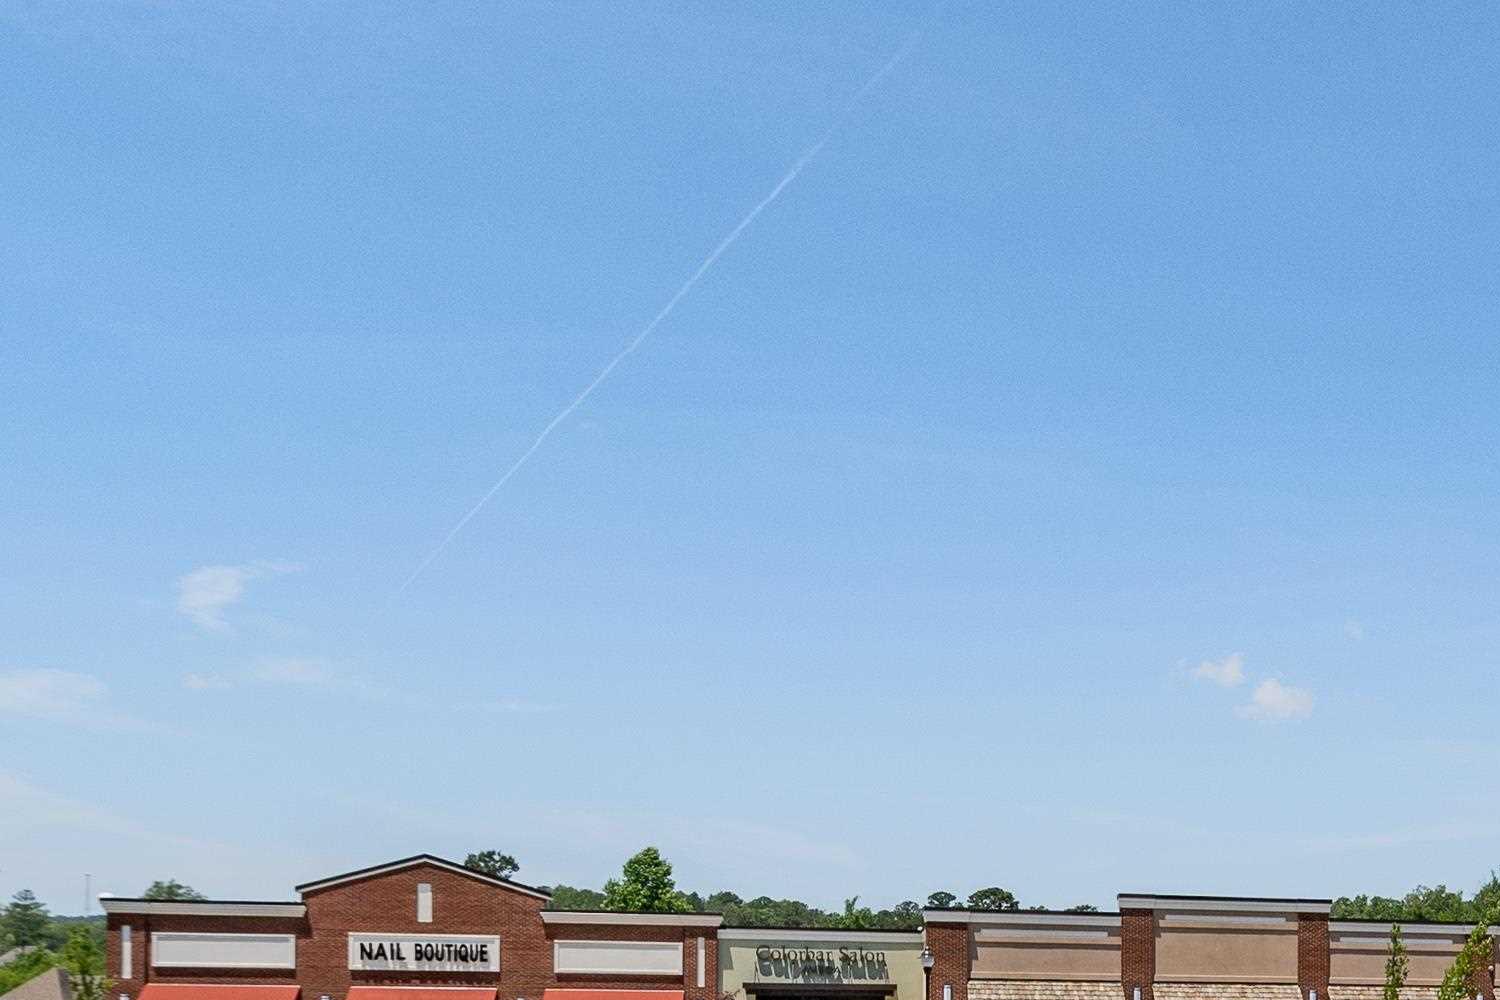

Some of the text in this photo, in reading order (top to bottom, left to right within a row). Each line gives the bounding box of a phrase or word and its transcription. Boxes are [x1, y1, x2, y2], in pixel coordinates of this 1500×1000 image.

[360, 943, 488, 962] NAIL BOUTIQUE
[756, 945, 886, 963] Colorbar Salon
